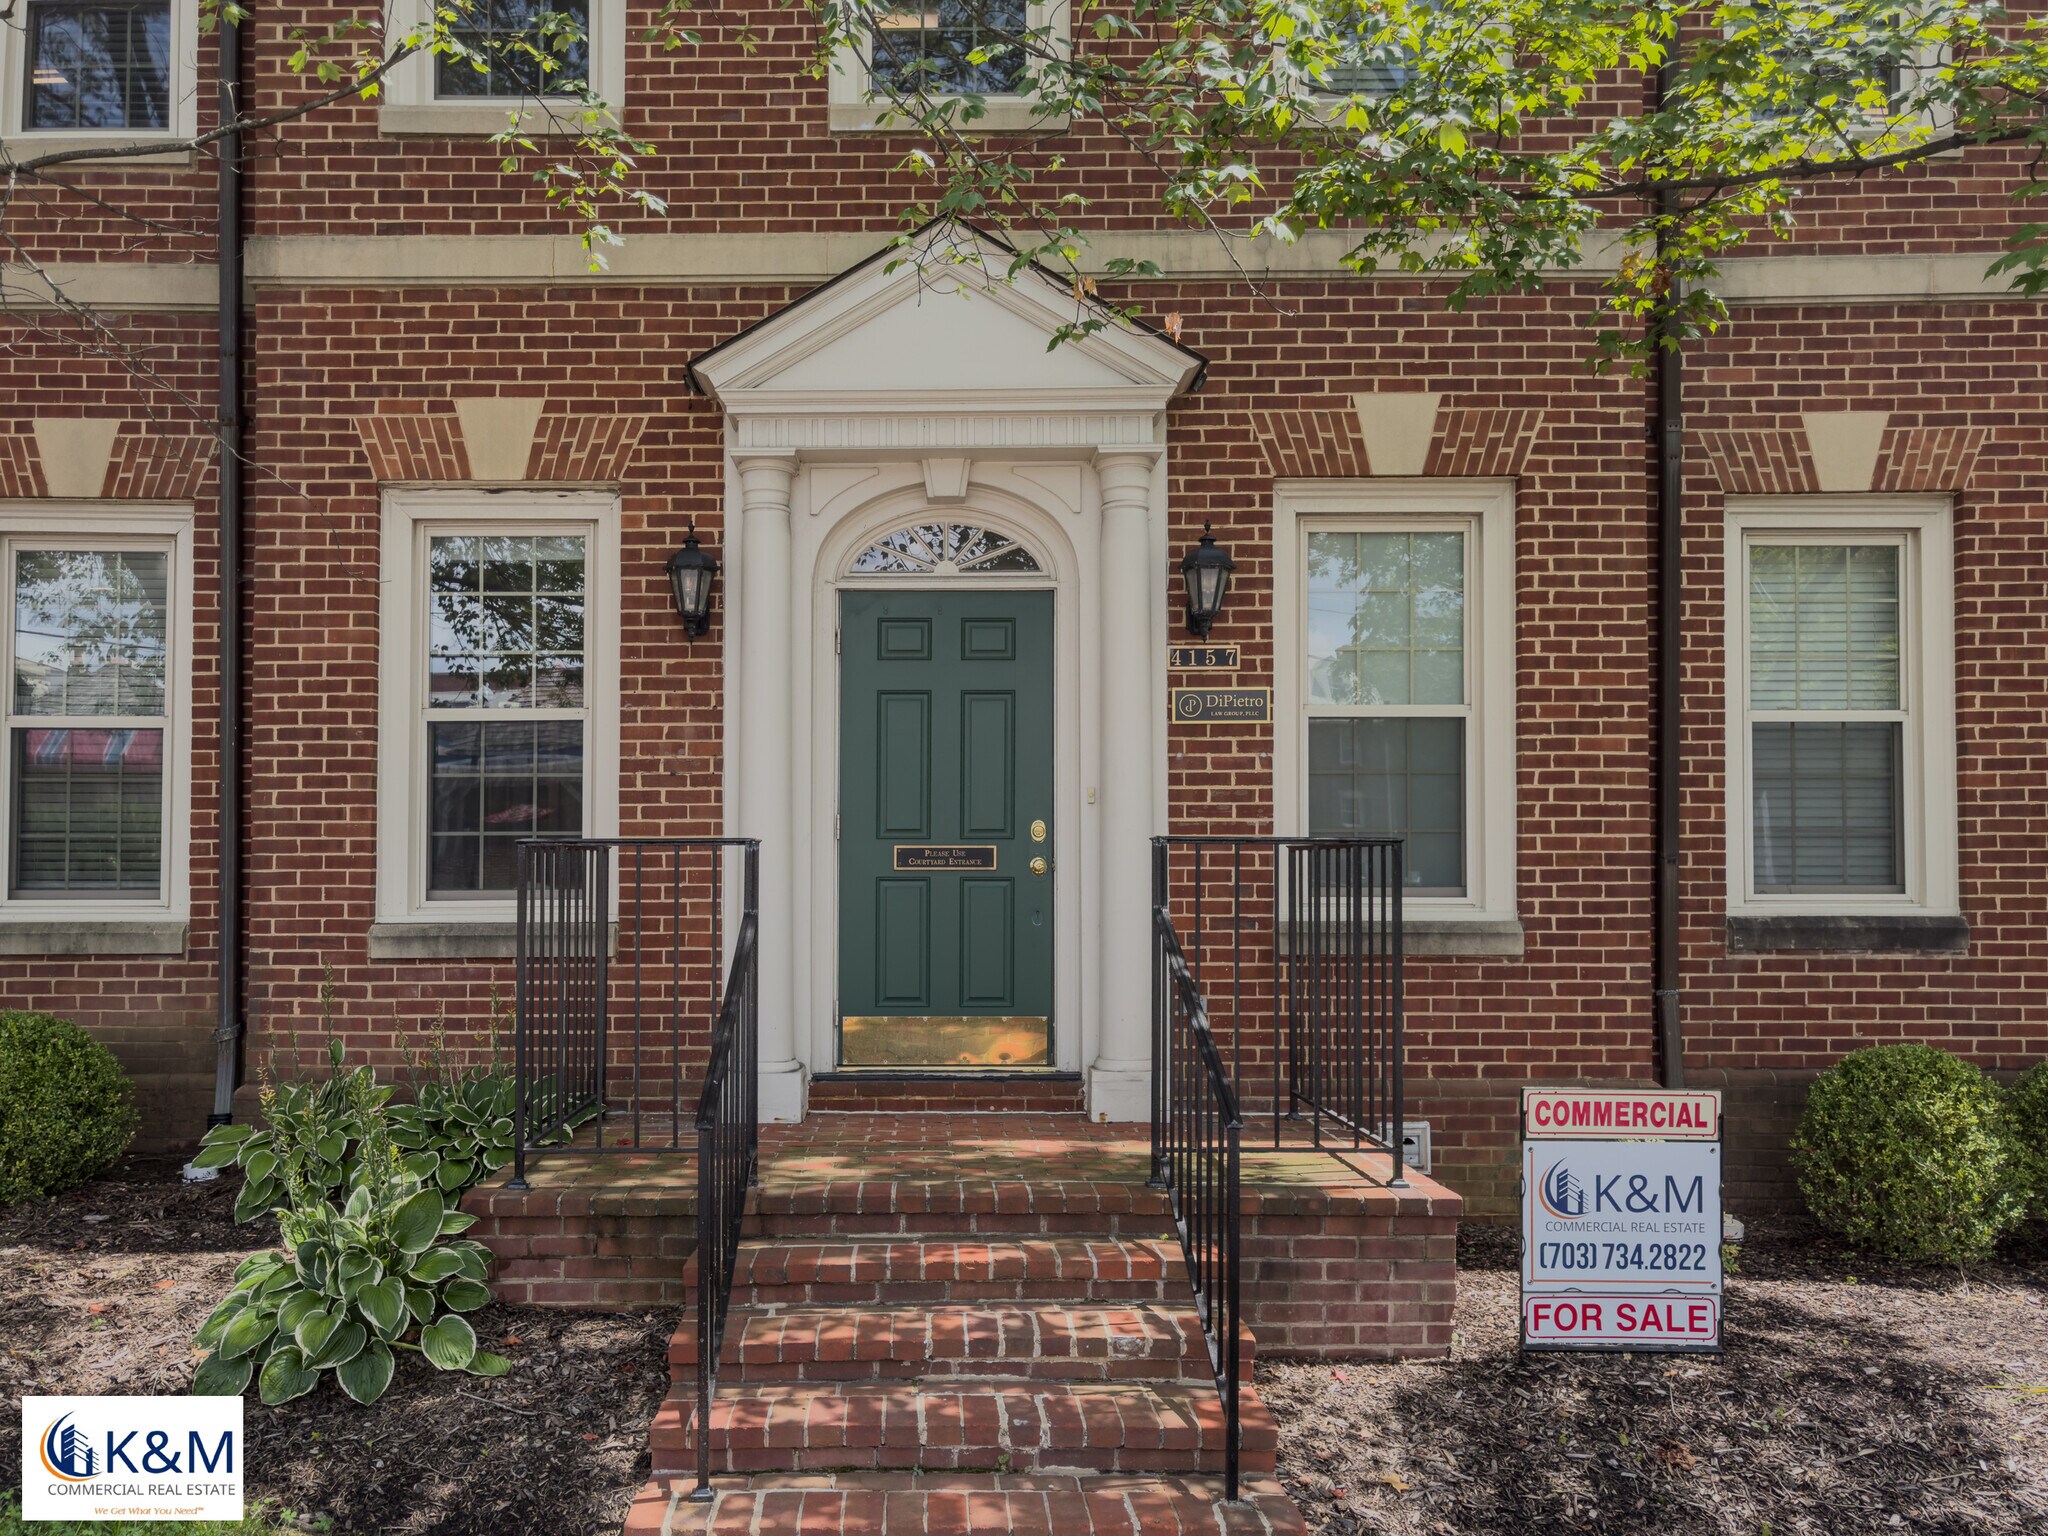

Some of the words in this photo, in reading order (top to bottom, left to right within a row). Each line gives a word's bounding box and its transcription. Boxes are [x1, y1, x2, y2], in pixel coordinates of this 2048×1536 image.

[1171, 649, 1236, 666] 4157
[1206, 694, 1264, 708] DiPietro
[1534, 1100, 1708, 1128] COMMERCIAL
[1595, 1174, 1703, 1214] K&M
[1545, 1221, 1627, 1233] COMMERCIAL
[1631, 1222, 1660, 1233] REAL
[1663, 1222, 1705, 1234] ESTATE
[1540, 1242, 1597, 1270] (703)
[1602, 1243, 1706, 1271] 734.2822
[1533, 1303, 1602, 1331] FOR
[1616, 1303, 1708, 1333] SALE
